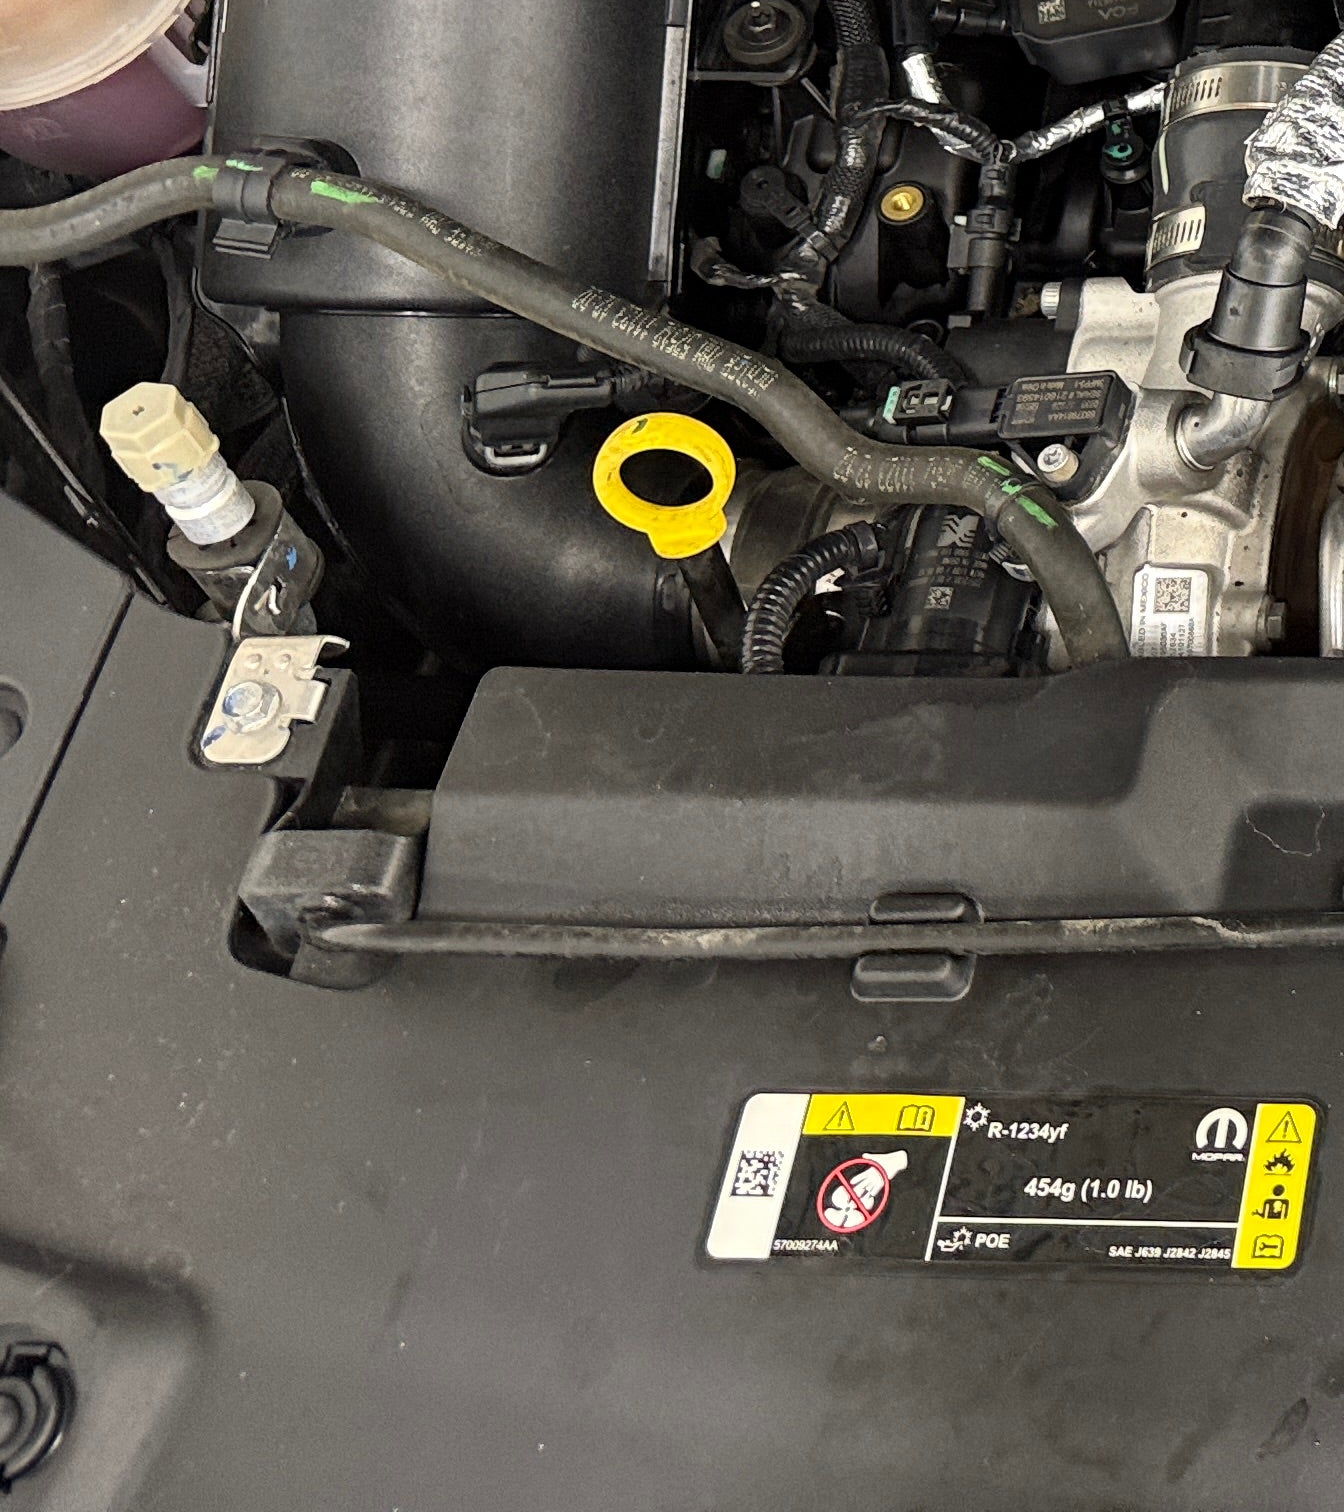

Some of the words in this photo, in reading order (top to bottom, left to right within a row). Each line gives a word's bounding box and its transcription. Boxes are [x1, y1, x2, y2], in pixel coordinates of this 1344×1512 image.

[987, 1121, 1070, 1143] R-1234yf
[1024, 1176, 1077, 1202] 454g
[1081, 1178, 1121, 1203] (1.0
[1125, 1179, 1153, 1203] lb)
[773, 1238, 839, 1252] 57009274AA
[975, 1233, 1011, 1249] POE
[1109, 1245, 1134, 1258] SAE
[1134, 1246, 1162, 1259] J639
